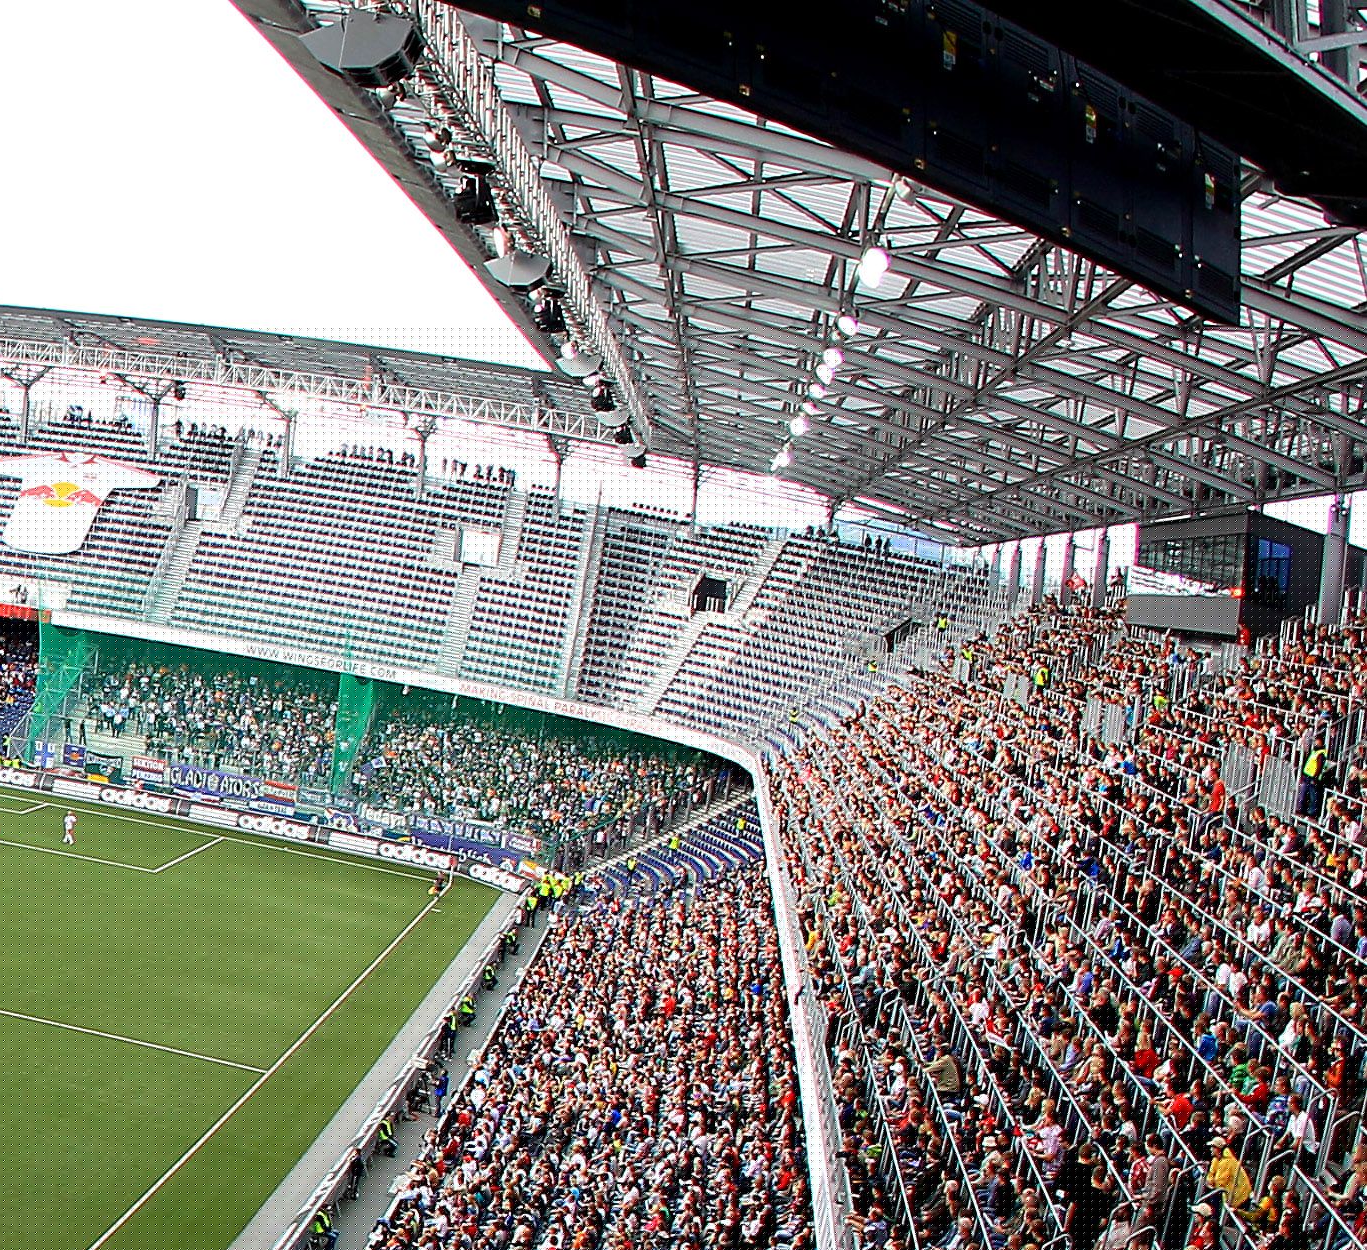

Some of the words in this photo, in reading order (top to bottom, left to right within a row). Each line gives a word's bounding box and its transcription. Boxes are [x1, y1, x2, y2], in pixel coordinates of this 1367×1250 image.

[100, 788, 172, 812] adidas
[238, 814, 310, 839] adidas
[379, 842, 452, 868] adidas
